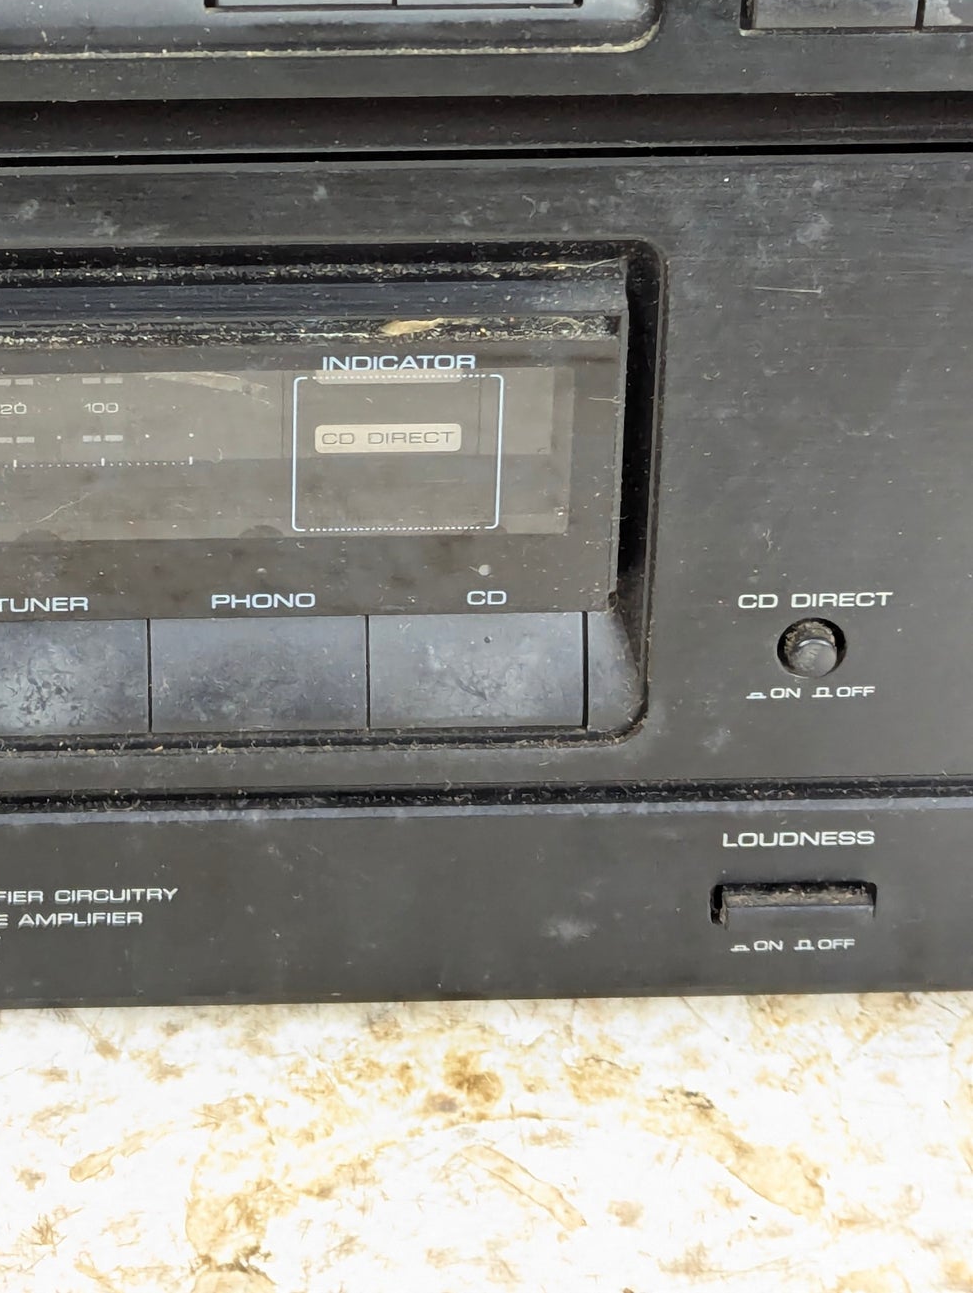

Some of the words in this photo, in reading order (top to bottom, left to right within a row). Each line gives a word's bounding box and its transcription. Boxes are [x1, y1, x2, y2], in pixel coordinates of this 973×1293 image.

[321, 354, 476, 373] INDICATOR
[0, 401, 28, 415] 20
[84, 402, 119, 414] 100
[321, 432, 356, 445] CD
[367, 431, 455, 445] DIRECT
[211, 592, 316, 609] PHONO
[466, 590, 507, 606] CD
[737, 593, 779, 609] CD
[790, 591, 894, 608] DIRECT
[769, 687, 802, 699] ON
[836, 685, 876, 698] OFF
[722, 830, 875, 848] LOUDNESS
[54, 887, 179, 903] CIRCUITRY
[18, 911, 143, 927] AMPLIFIER
[753, 939, 784, 952] ON
[817, 938, 856, 950] OFF
